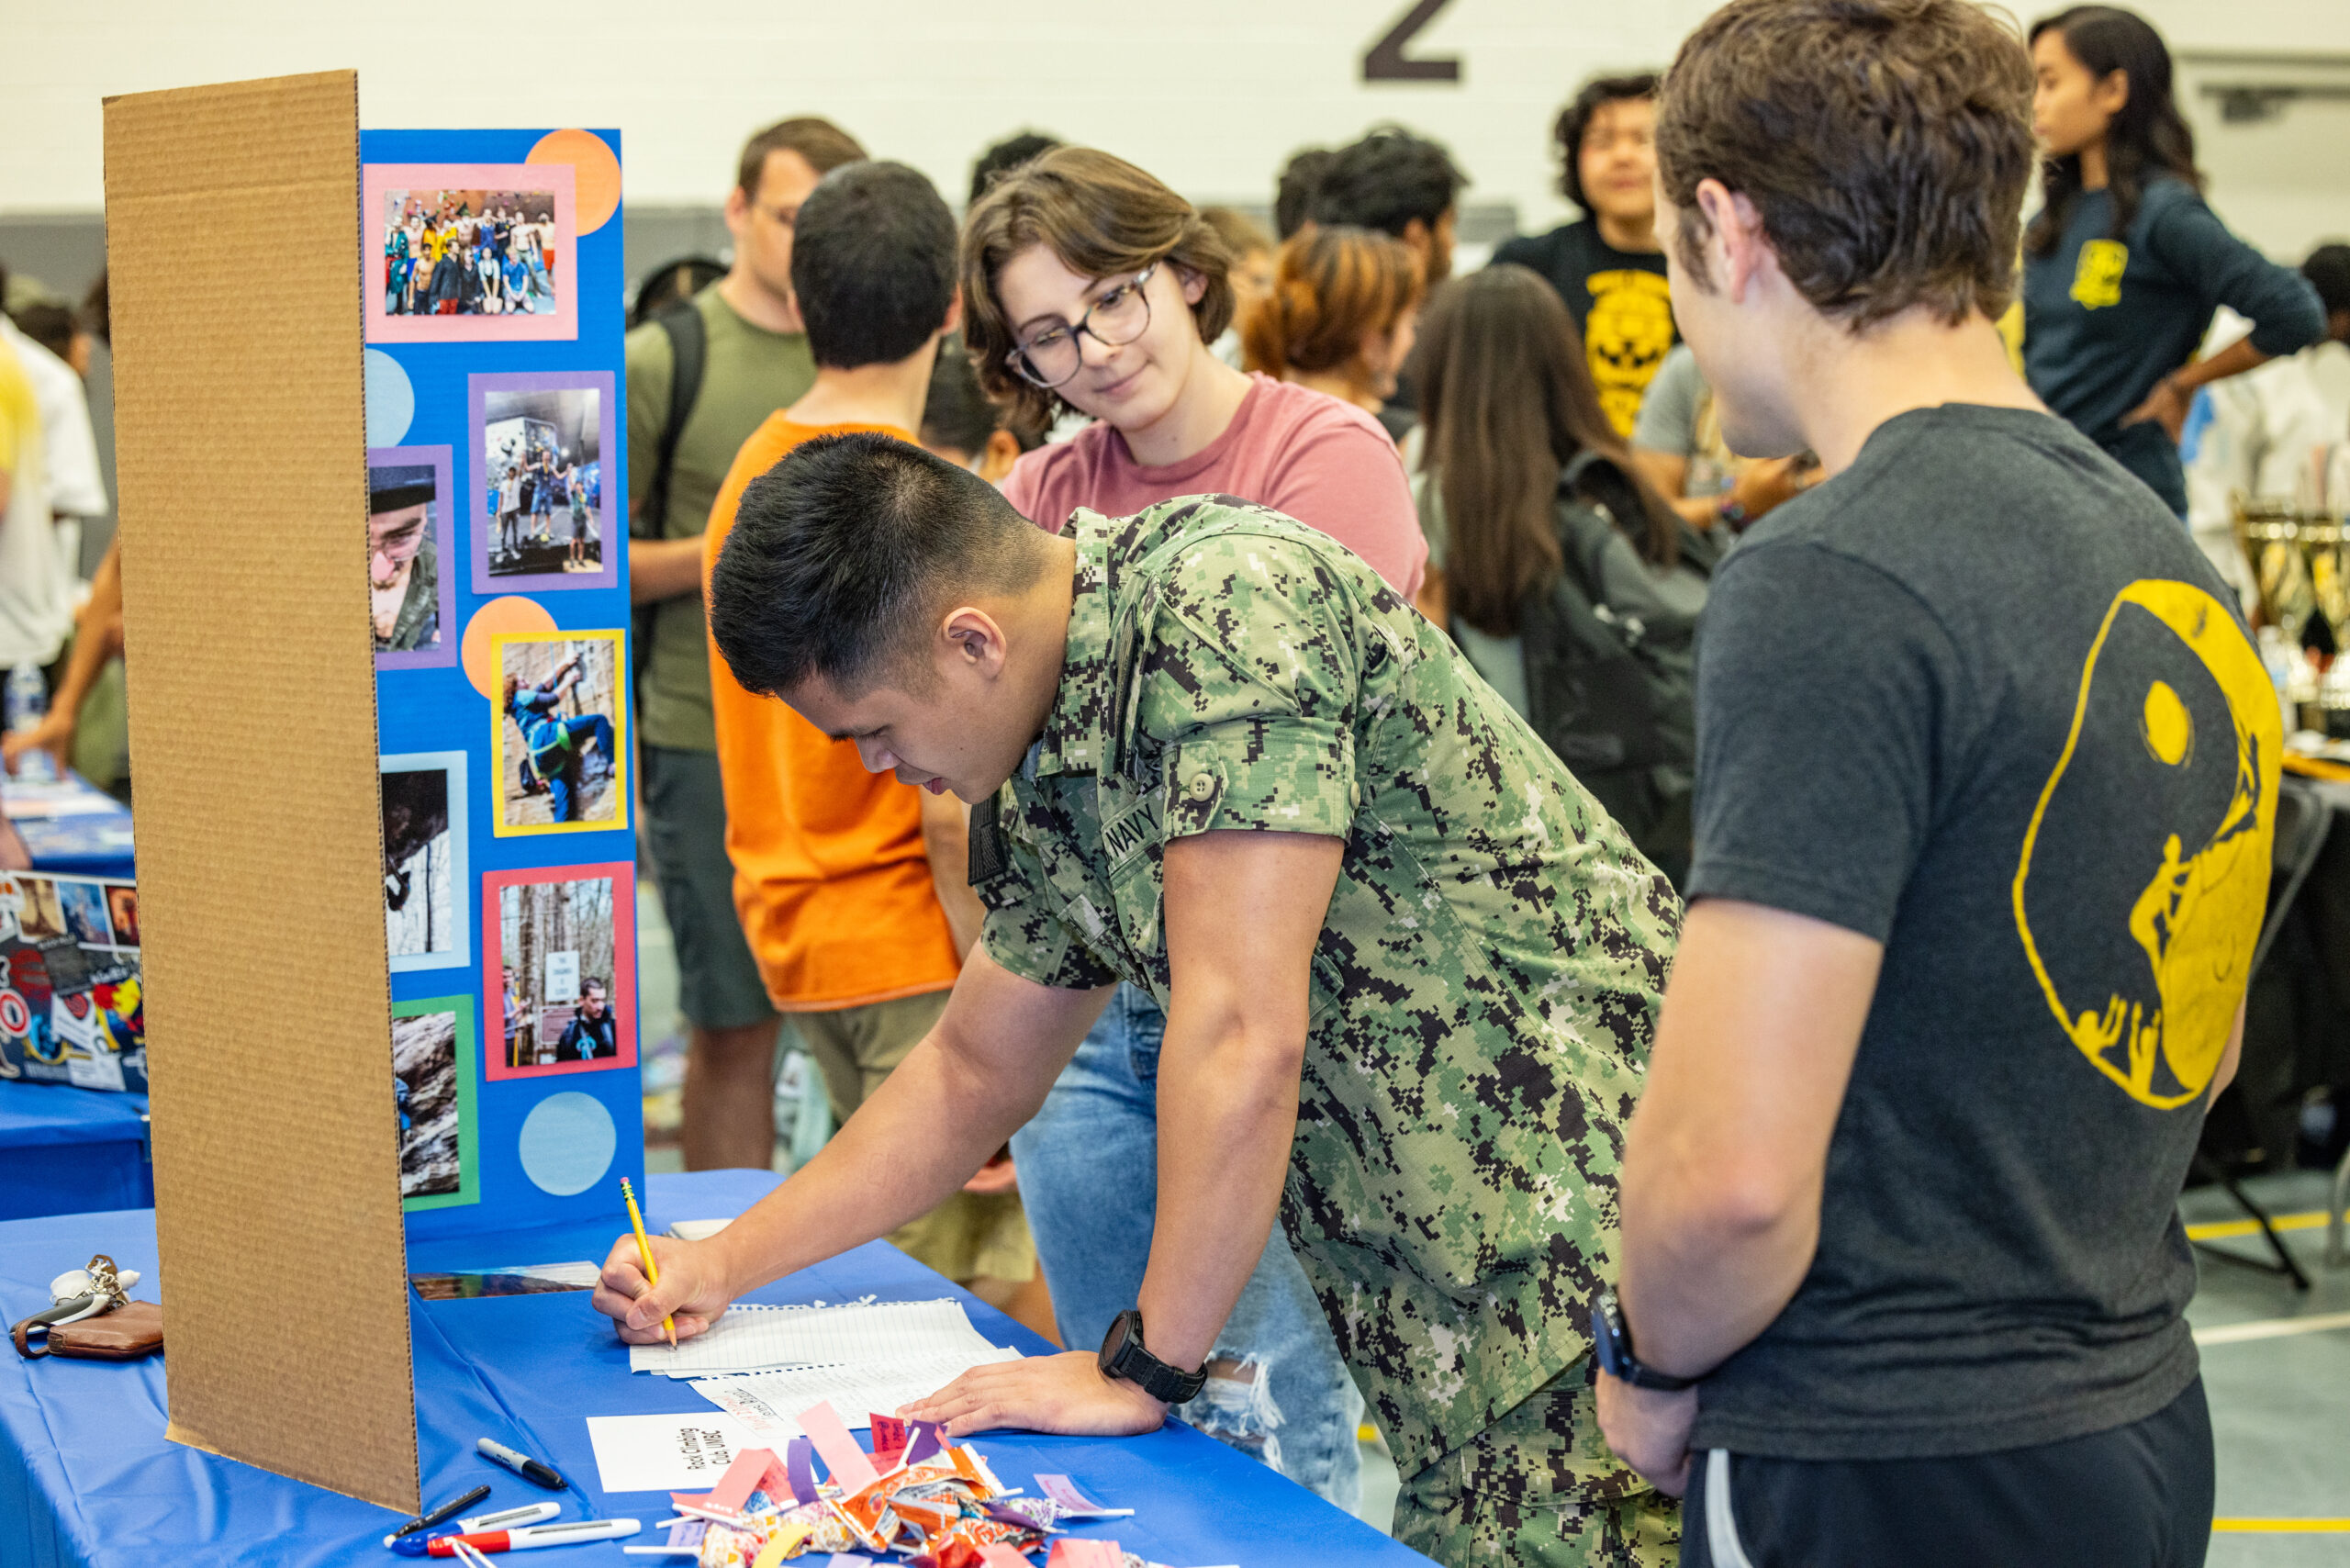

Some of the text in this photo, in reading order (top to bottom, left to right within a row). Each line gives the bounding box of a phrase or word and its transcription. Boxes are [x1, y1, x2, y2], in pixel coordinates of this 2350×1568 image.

[1105, 803, 1159, 857] NAVY
[676, 1428, 707, 1470] Rock Climbing
[701, 1430, 732, 1464] Club, UMBC
